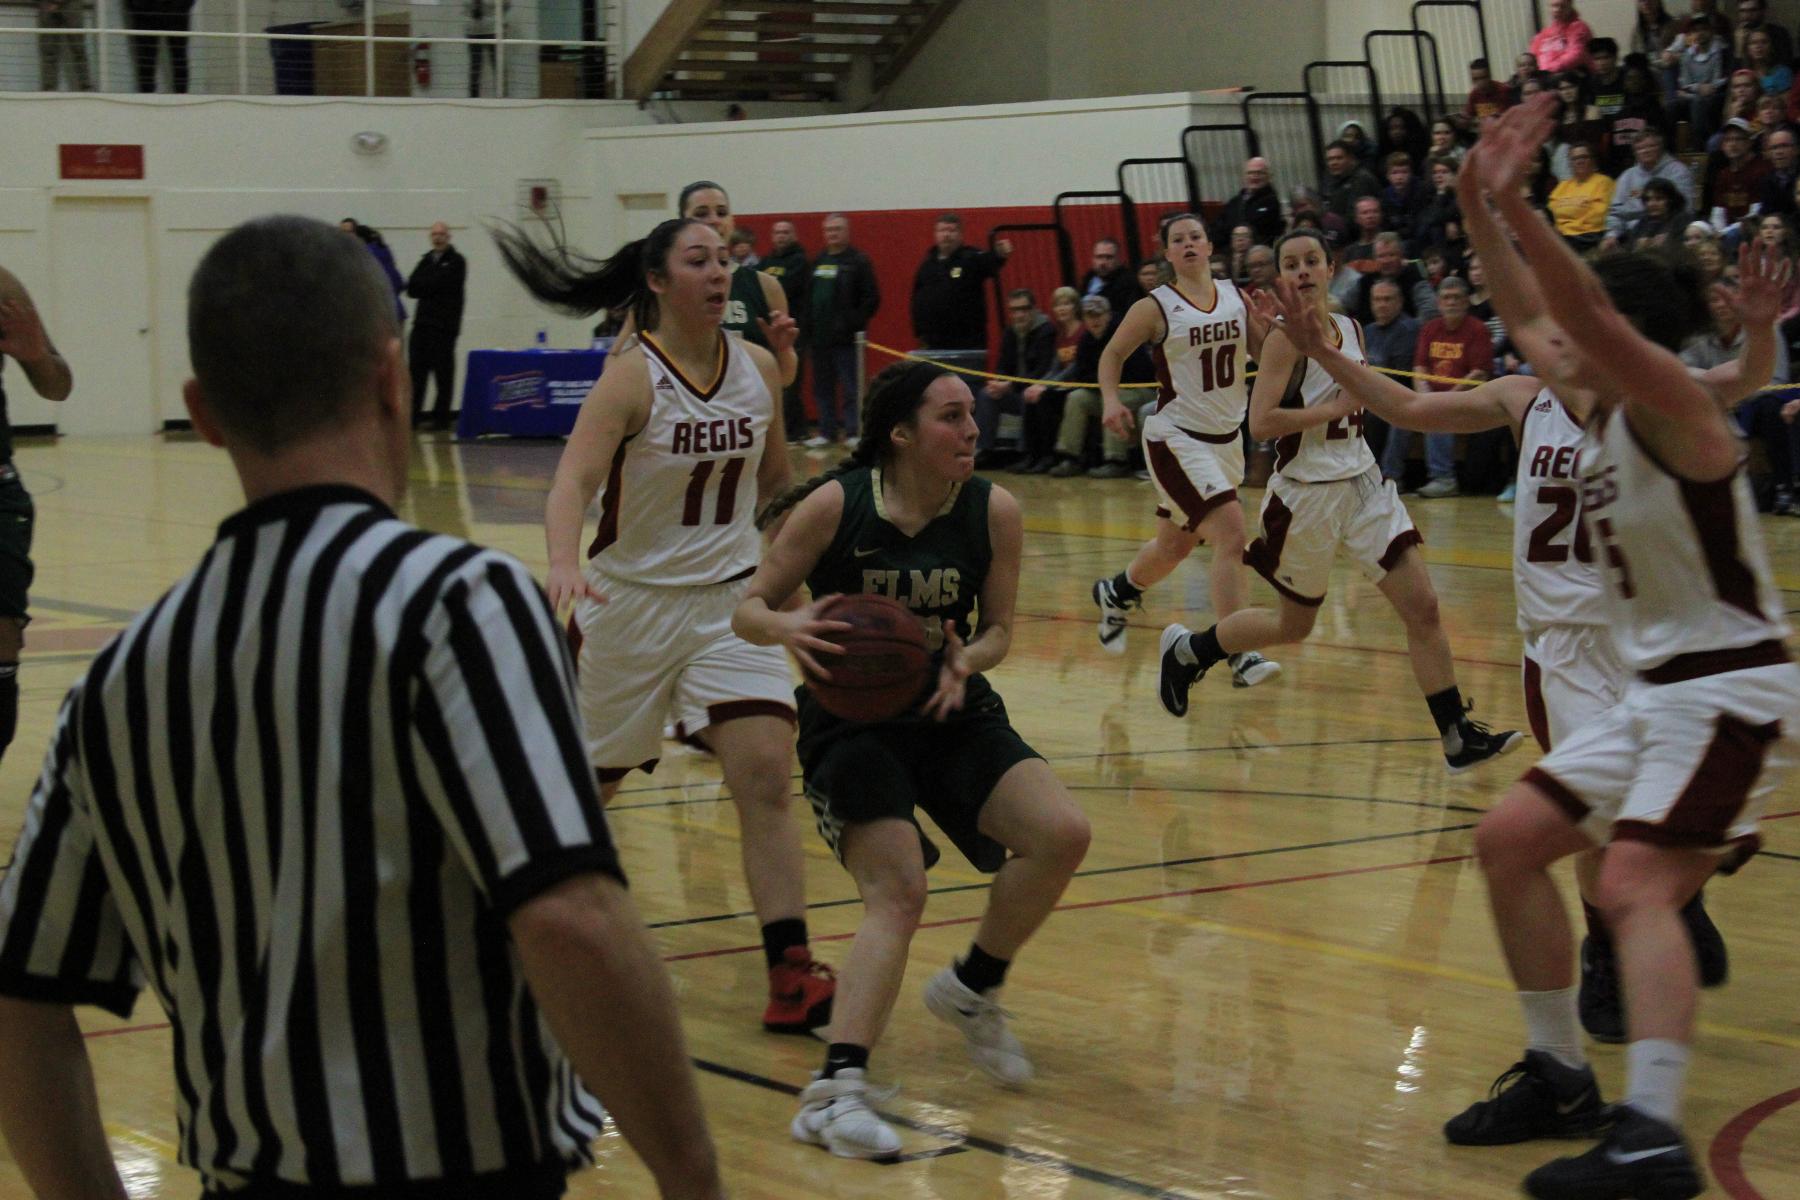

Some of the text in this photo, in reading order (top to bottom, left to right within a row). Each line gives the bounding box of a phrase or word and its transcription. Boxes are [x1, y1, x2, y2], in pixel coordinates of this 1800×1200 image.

[1189, 319, 1240, 347] REGIS
[1199, 344, 1237, 393] 10
[671, 416, 754, 455] REGIS
[681, 457, 746, 526] 11
[861, 567, 961, 608] ELMS
